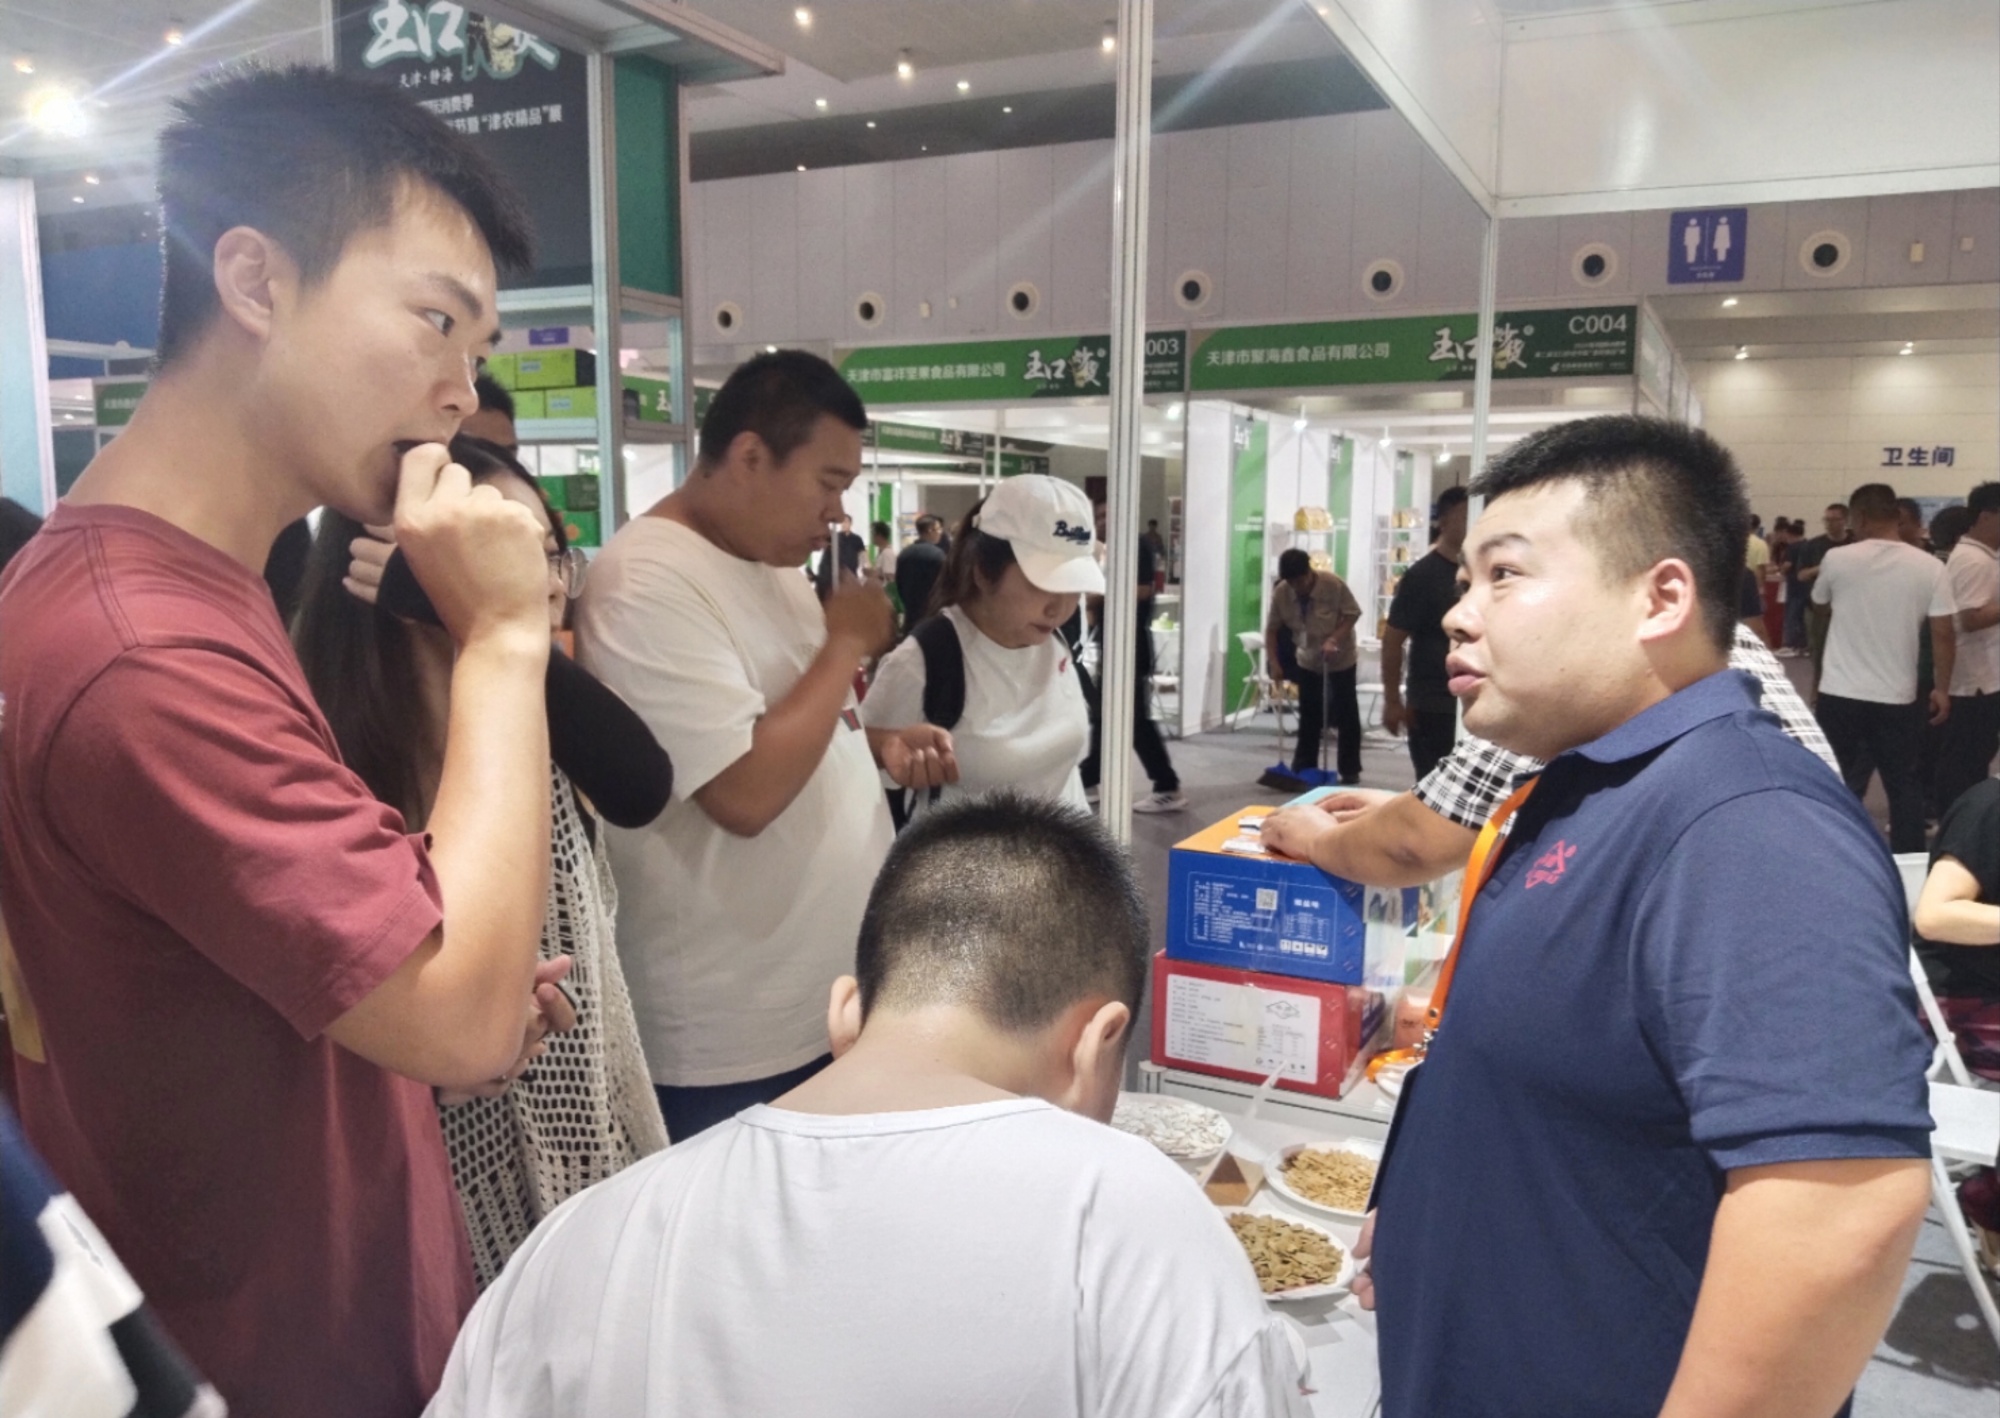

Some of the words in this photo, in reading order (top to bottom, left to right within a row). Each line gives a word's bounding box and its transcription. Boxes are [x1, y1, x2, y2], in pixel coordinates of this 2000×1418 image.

[416, 93, 474, 115] 际消费季
[444, 104, 563, 134] 节暨“津农精品”展
[1568, 313, 1627, 335] C004
[1145, 337, 1180, 357] 003
[1206, 342, 1390, 367] 天津市聚海鑫食品有限公司
[1881, 446, 1955, 468] 卫生间
